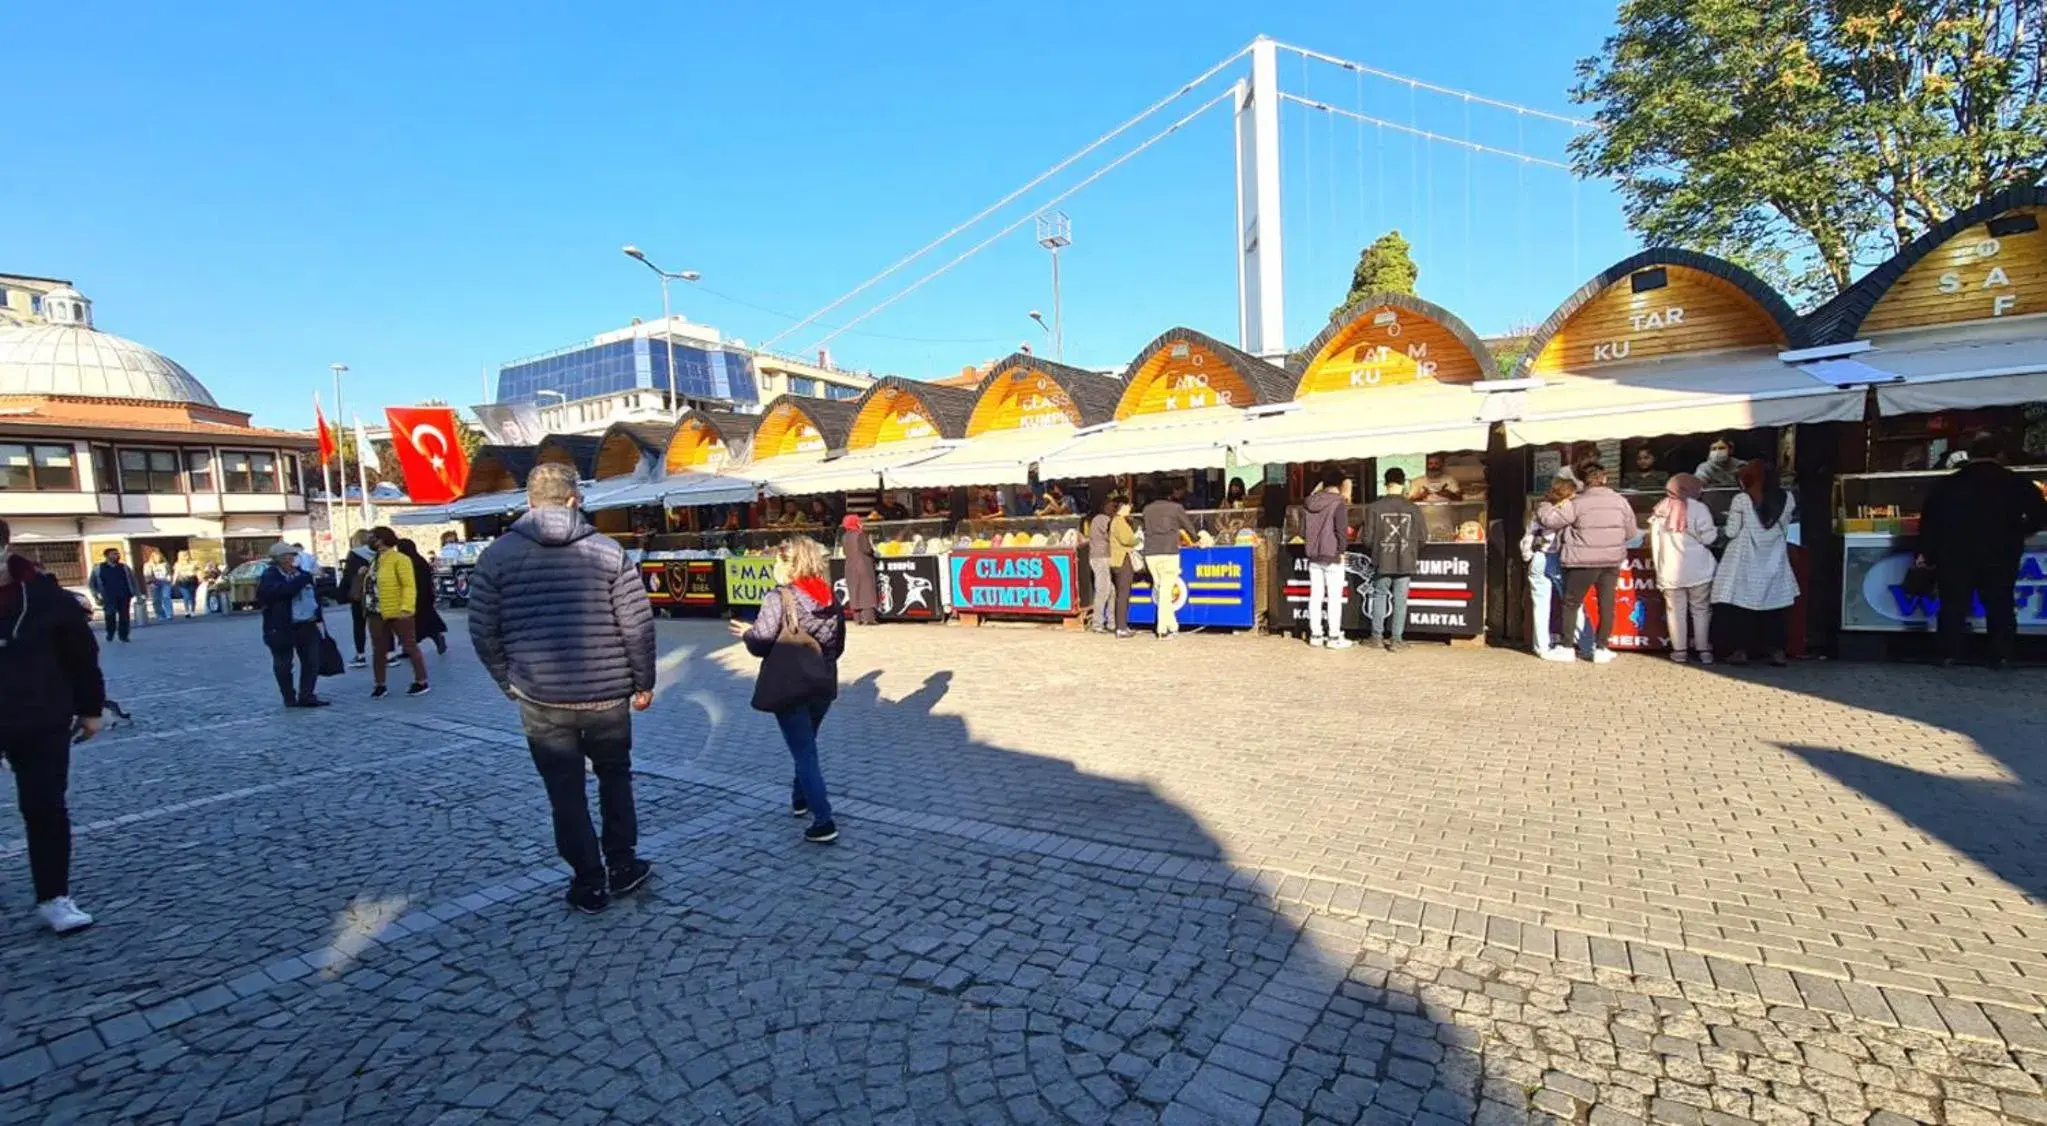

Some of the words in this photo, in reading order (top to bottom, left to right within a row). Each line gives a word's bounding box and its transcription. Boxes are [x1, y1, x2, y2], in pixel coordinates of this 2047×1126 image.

[1628, 307, 1684, 332] TAR
[1593, 340, 1630, 361] KU
[741, 564, 774, 580] MA
[975, 558, 1043, 579] CLASS
[1195, 561, 1242, 578] KUMPİR
[970, 581, 1052, 607] KUMPİR
[1409, 612, 1467, 626] KARTAL
